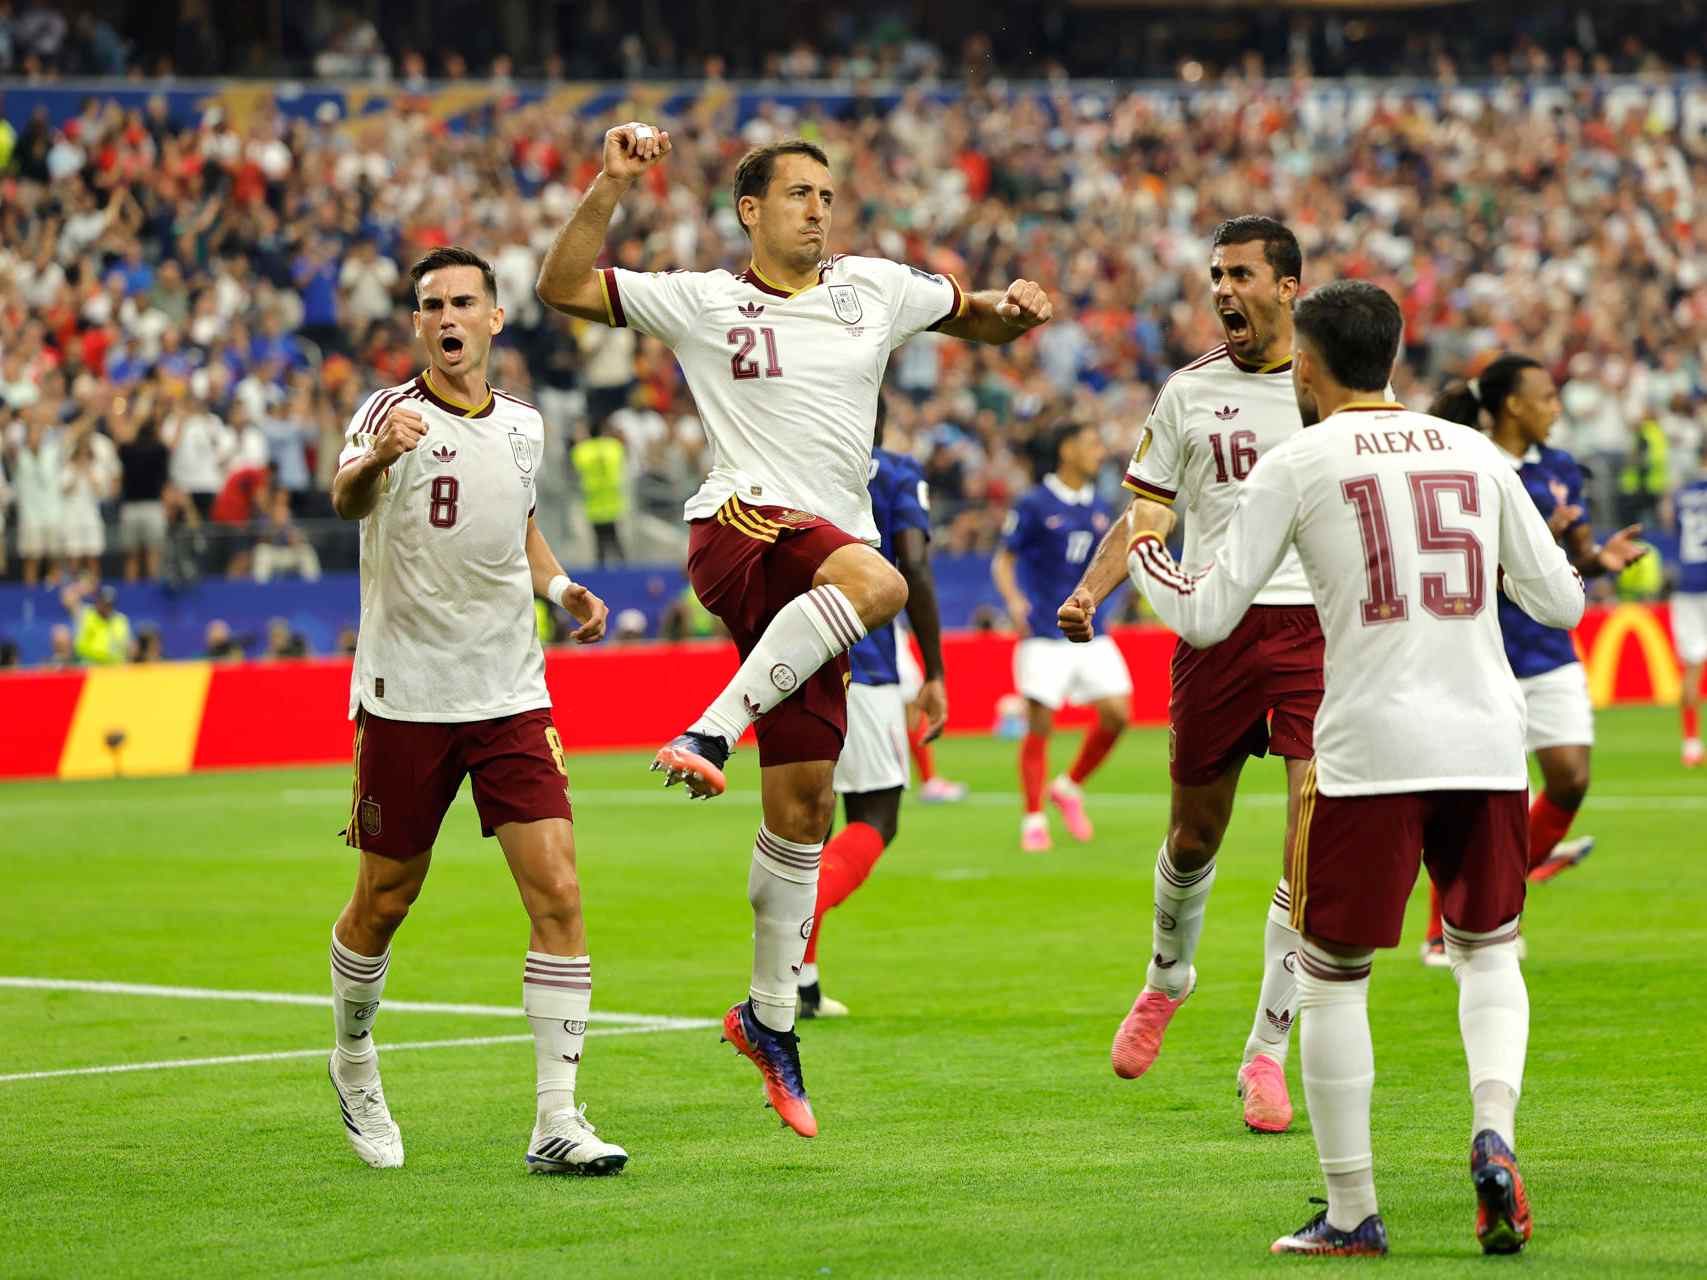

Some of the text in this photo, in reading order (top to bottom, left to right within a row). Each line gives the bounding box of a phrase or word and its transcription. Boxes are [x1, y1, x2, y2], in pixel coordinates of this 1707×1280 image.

[726, 326, 782, 380] 21
[1208, 430, 1258, 484] 16
[1354, 428, 1452, 456] ALEX B.
[428, 475, 459, 529] 8
[1340, 470, 1487, 627] 15
[544, 726, 568, 777] 8
